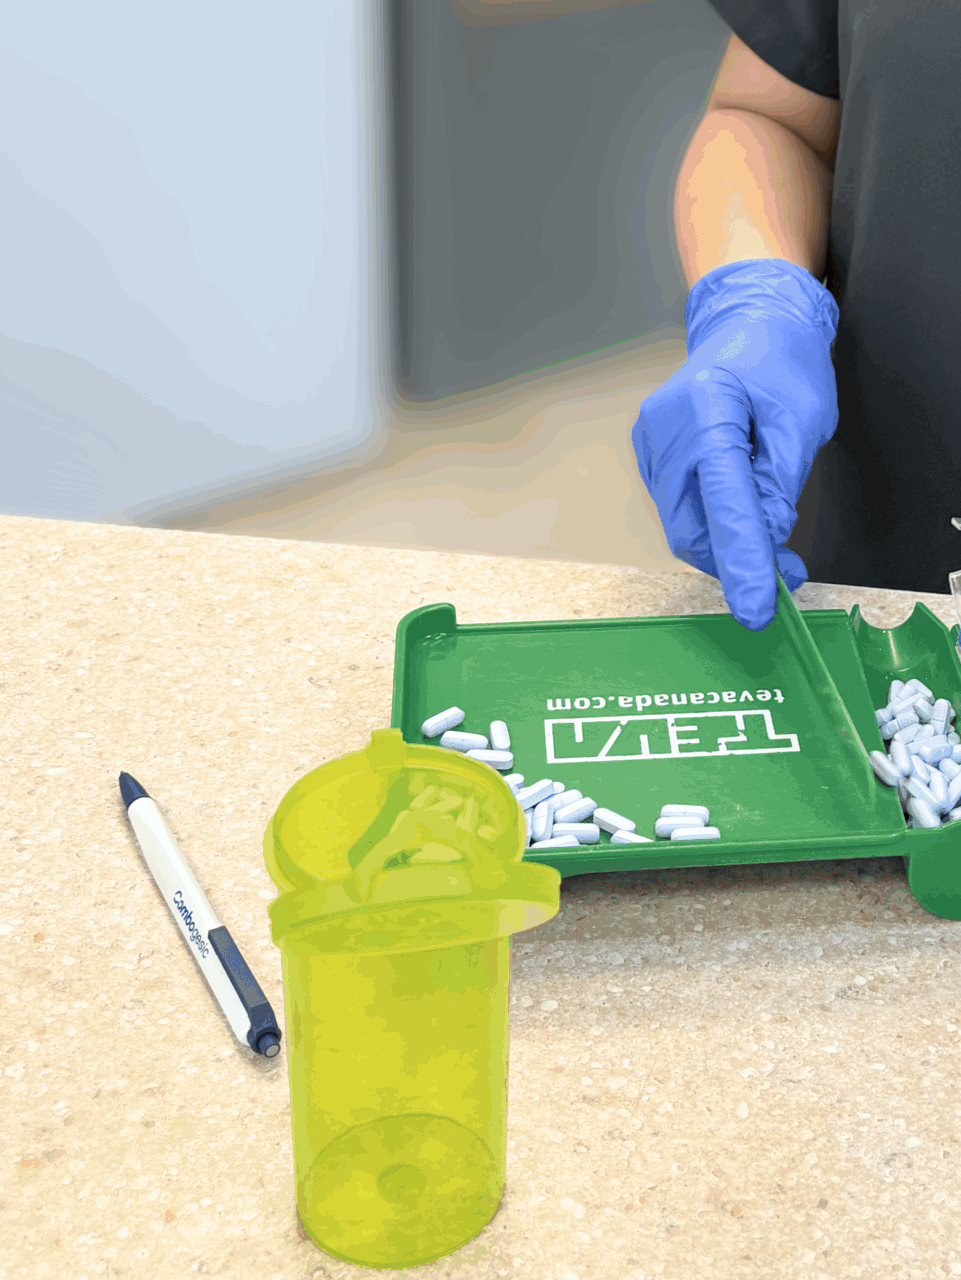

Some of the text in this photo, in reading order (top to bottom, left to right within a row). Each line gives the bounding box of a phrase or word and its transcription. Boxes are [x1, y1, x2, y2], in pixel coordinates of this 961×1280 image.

[546, 688, 785, 712] tevacanada.com
[543, 709, 801, 764] TEVA
[173, 890, 210, 959] Combogesic
